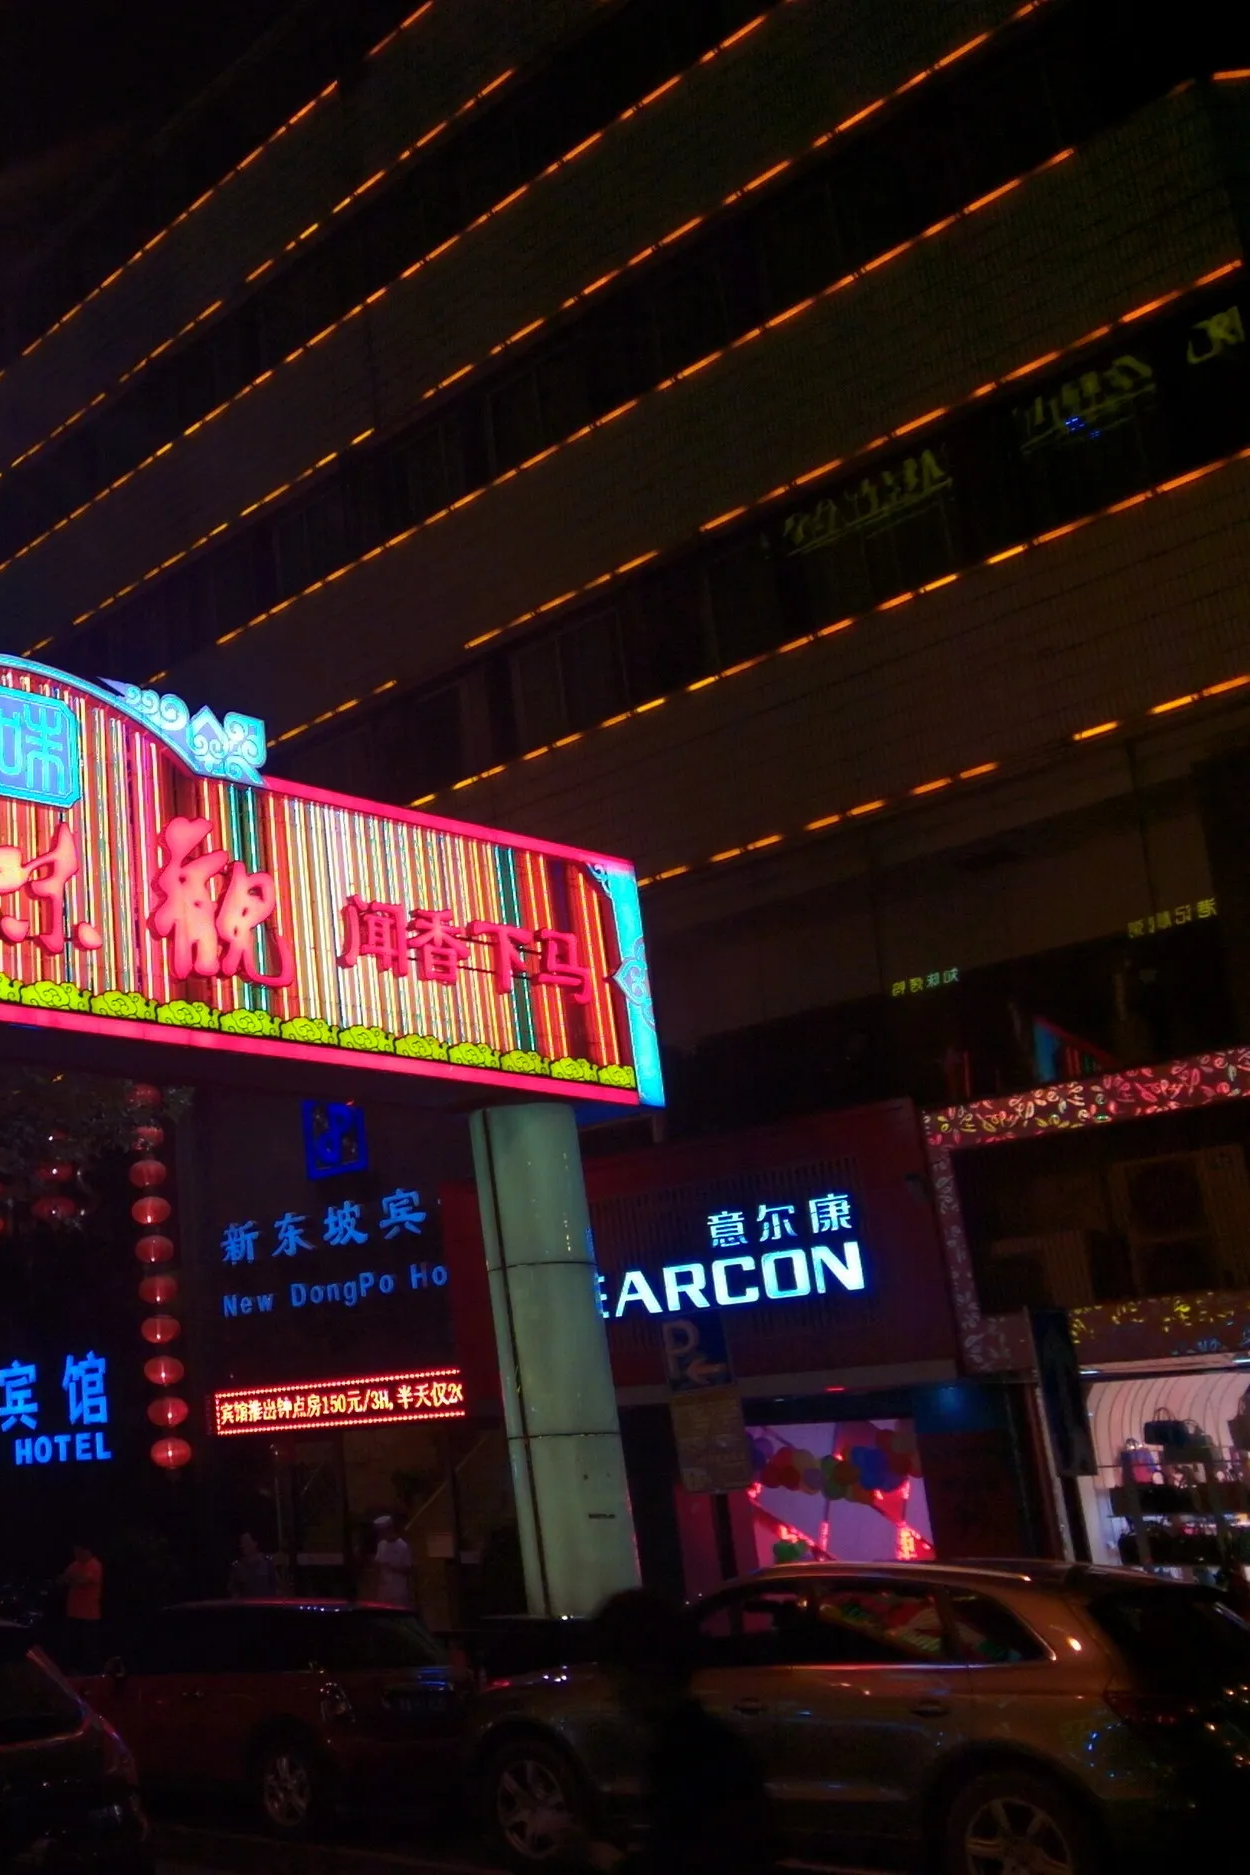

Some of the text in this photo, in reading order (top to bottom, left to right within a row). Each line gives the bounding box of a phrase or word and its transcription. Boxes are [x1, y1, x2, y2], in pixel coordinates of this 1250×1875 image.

[337, 893, 592, 1004] 闻香下马
[221, 1188, 427, 1266] 新东坡宾
[707, 1193, 852, 1248] 意尔康
[222, 1262, 448, 1319] New DongPo Ho
[662, 1319, 700, 1381] P
[15, 1432, 112, 1465] HOTEL
